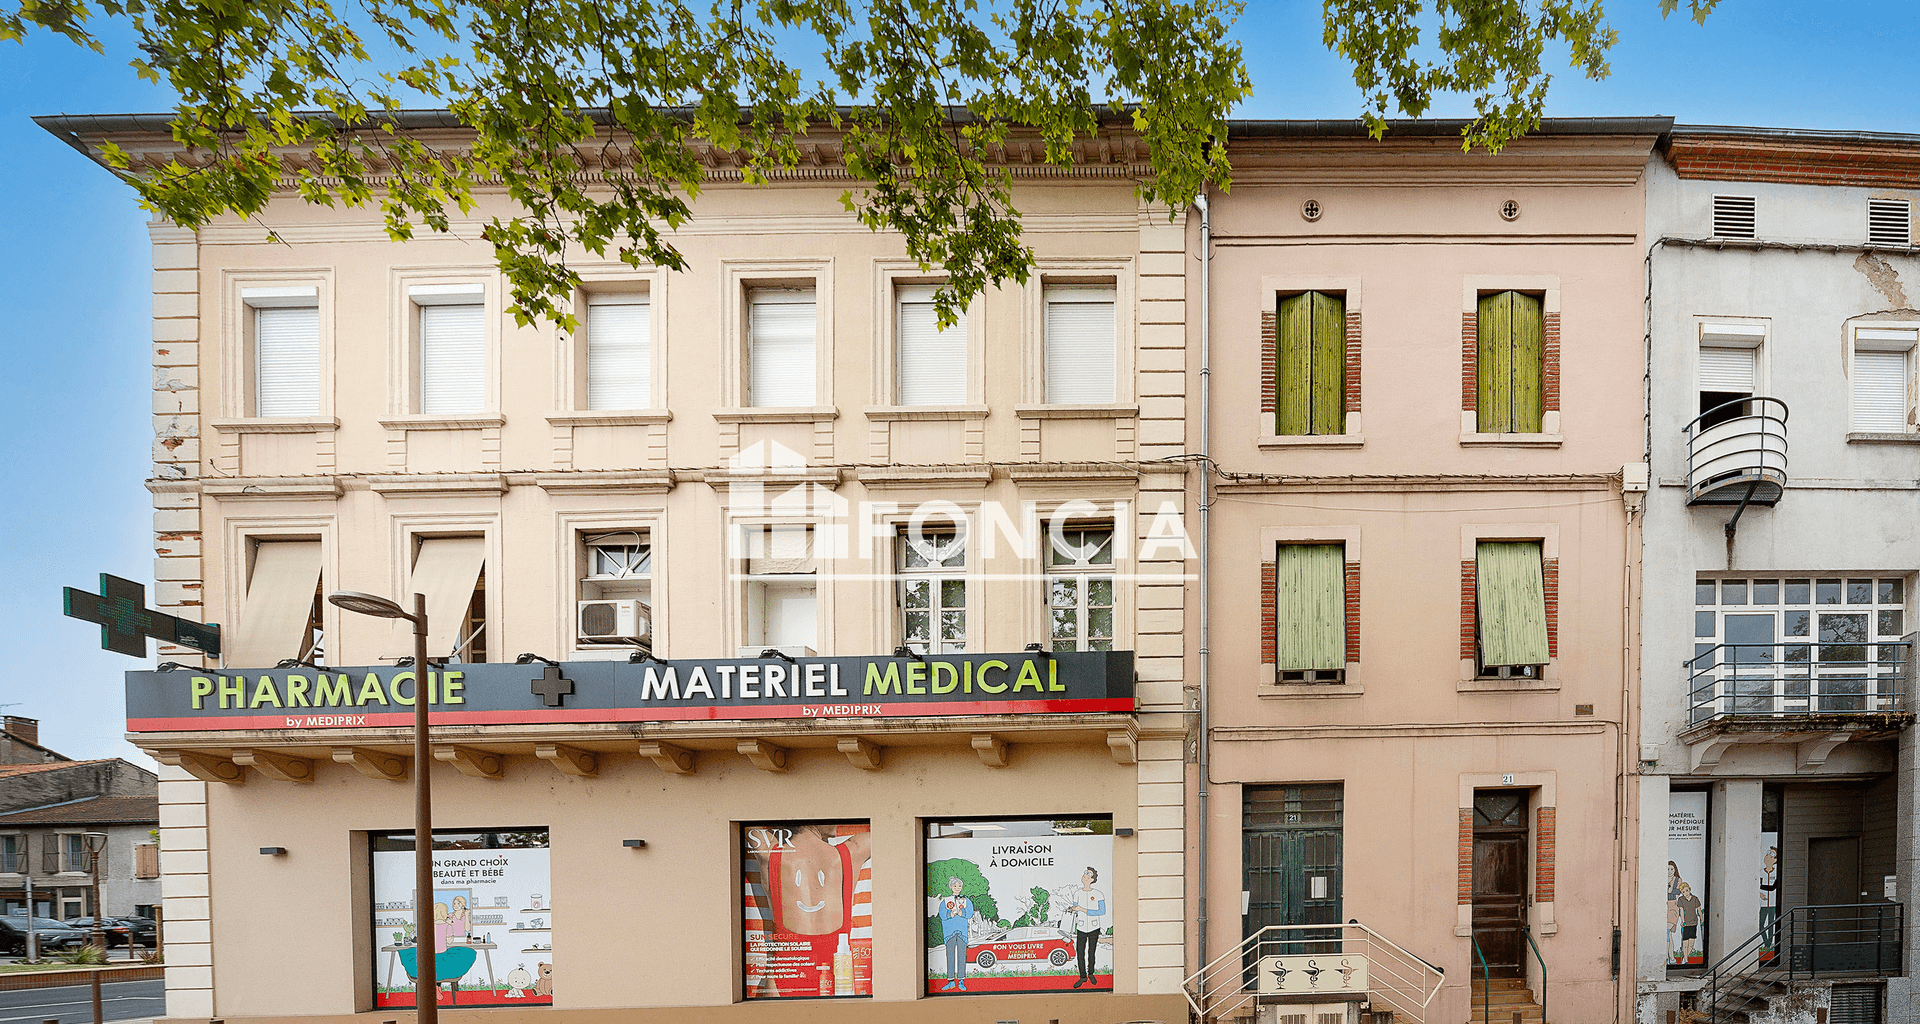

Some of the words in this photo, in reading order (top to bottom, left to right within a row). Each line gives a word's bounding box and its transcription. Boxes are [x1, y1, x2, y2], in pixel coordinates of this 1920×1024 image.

[641, 664, 848, 700] MATERIEL
[863, 659, 1066, 695] MEDICAL
[191, 671, 464, 709] PHARMACIE
[803, 706, 818, 716] by
[822, 704, 882, 715] MEDIPRIX
[286, 717, 302, 728] by
[306, 715, 365, 726] MEDIPRIX
[1503, 775, 1512, 783] 21
[747, 829, 796, 849] SVR
[992, 845, 1052, 854] LIVRAISON
[443, 859, 477, 868] GRAND
[479, 858, 509, 867] CHOIX
[990, 856, 998, 867] À
[1001, 858, 1054, 867] DOMICILE
[433, 868, 466, 878] BEAUTÉ
[482, 867, 504, 877] BÉBÉ
